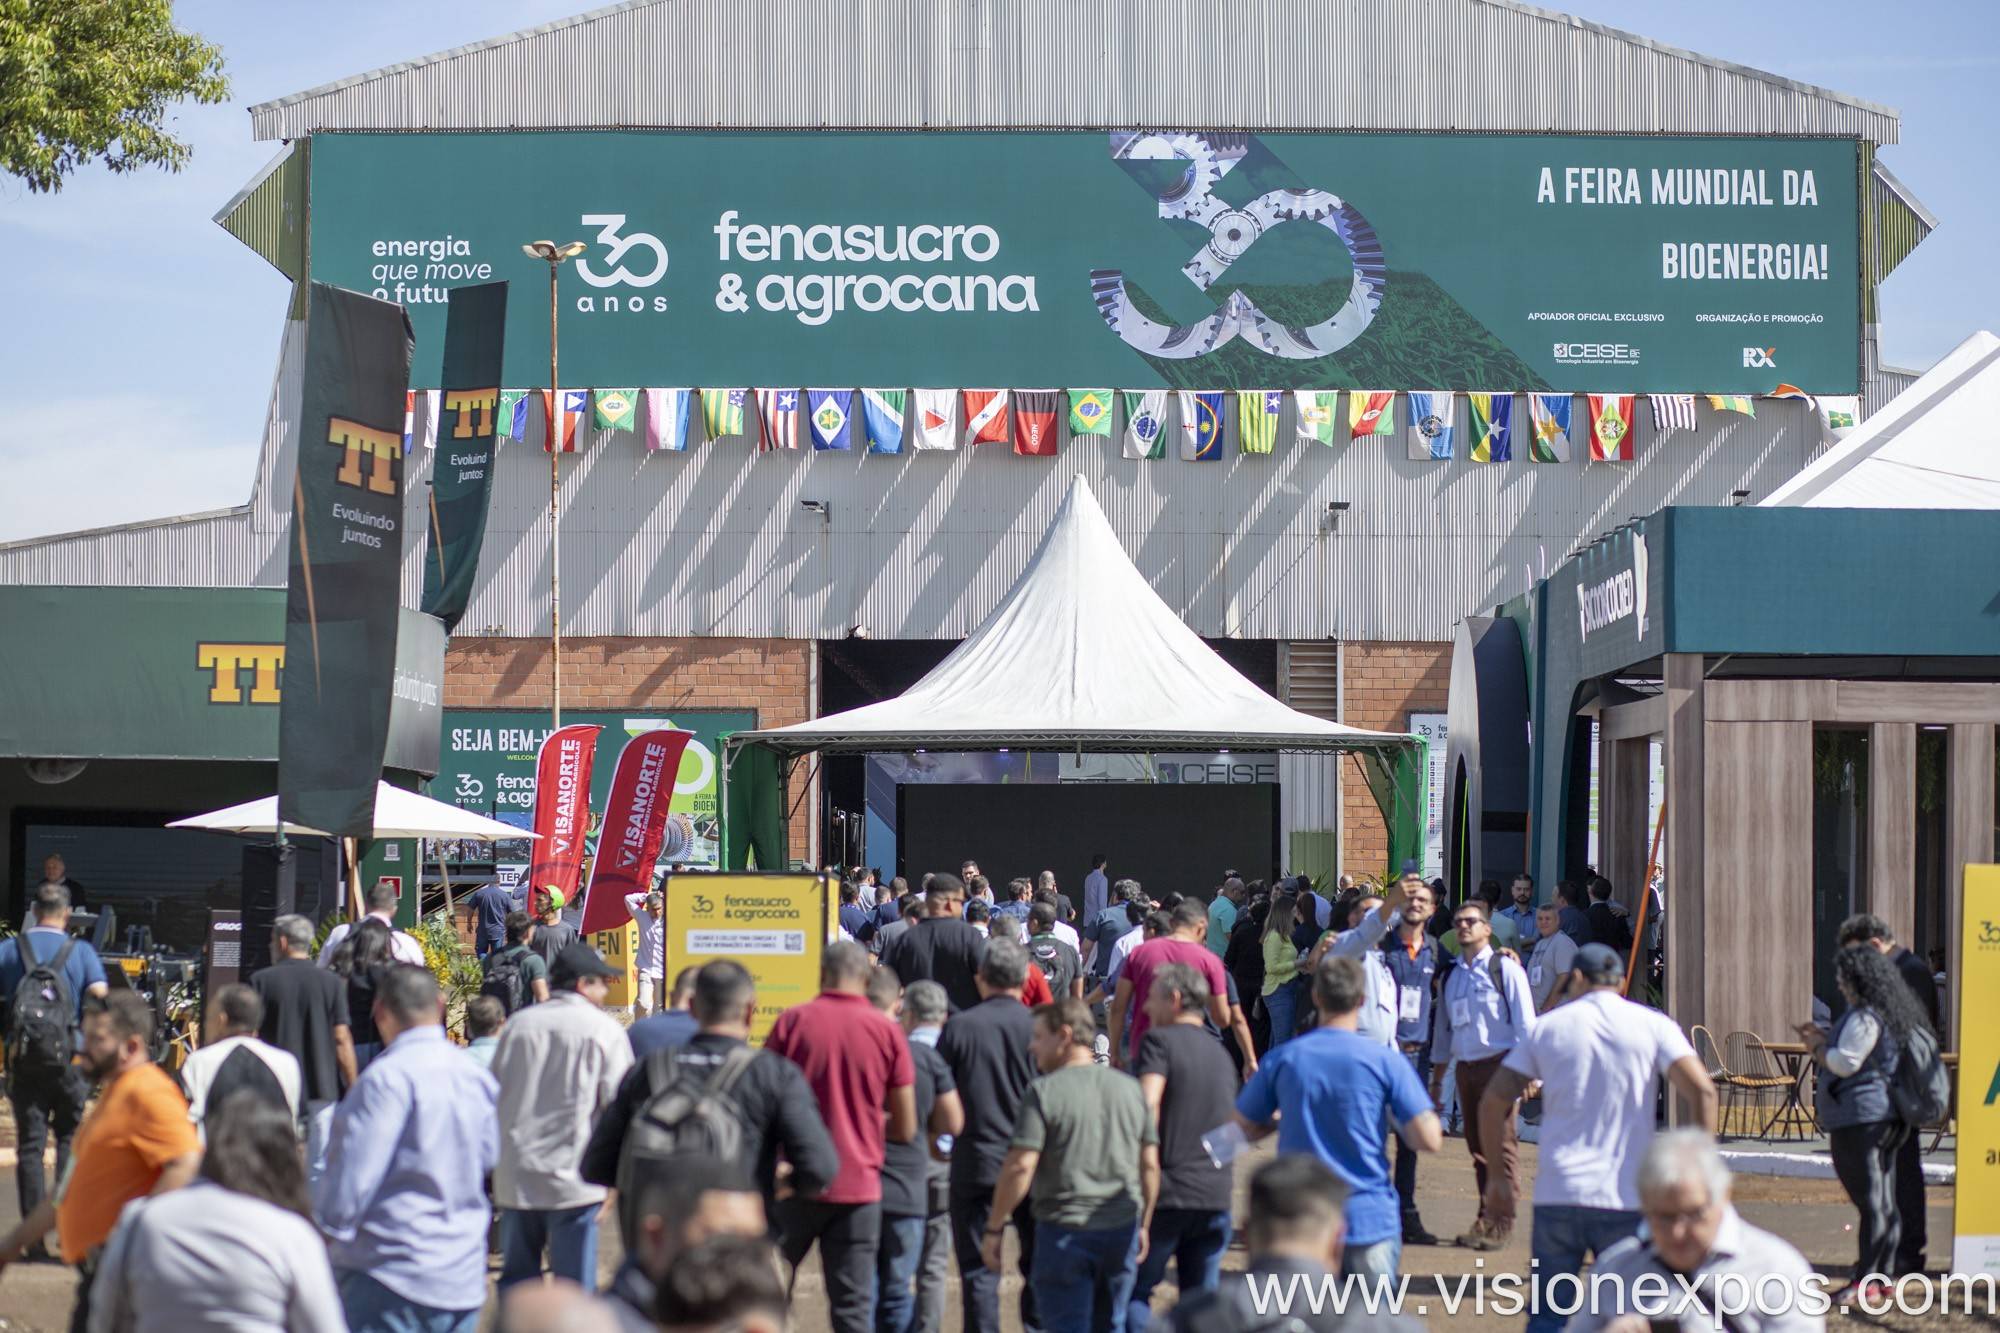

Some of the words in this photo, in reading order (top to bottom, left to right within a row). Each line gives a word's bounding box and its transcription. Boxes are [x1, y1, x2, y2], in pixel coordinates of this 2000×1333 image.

[1537, 167, 1555, 203] A
[1565, 167, 1642, 204] FEIRA
[1651, 168, 1773, 206] MUNDIAL
[1783, 170, 1818, 206] DA
[713, 210, 1000, 262] fenasucro
[372, 235, 471, 262] energia
[576, 214, 669, 288] 30
[1662, 242, 1828, 280] BIOENERGIA!
[372, 263, 418, 281] que
[425, 263, 491, 280] move
[395, 282, 449, 303] futu
[715, 273, 750, 313] &
[756, 274, 1040, 326] agrocana
[577, 295, 667, 312] anos
[1528, 312, 1575, 321] APOIADOR
[1577, 313, 1612, 321] OFICIAL
[1614, 313, 1665, 322] EXCLUSIVO
[1695, 313, 1761, 324] ORGANIZAÇÃO
[1763, 314, 1769, 322] E
[1771, 313, 1824, 324] PROMOÇÃO
[1568, 344, 1628, 358] CEISE
[1743, 347, 1776, 367] RX
[1031, 423, 1039, 446] NEGO
[457, 469, 484, 483] juntos
[332, 503, 395, 531] Evoluindo
[341, 525, 382, 548] juntos
[452, 729, 493, 751] SEJA
[455, 774, 484, 796] 30
[693, 801, 715, 811] BIOEN
[692, 895, 714, 912] 30
[724, 894, 791, 907] fenasucro
[734, 909, 800, 921] agrocana
